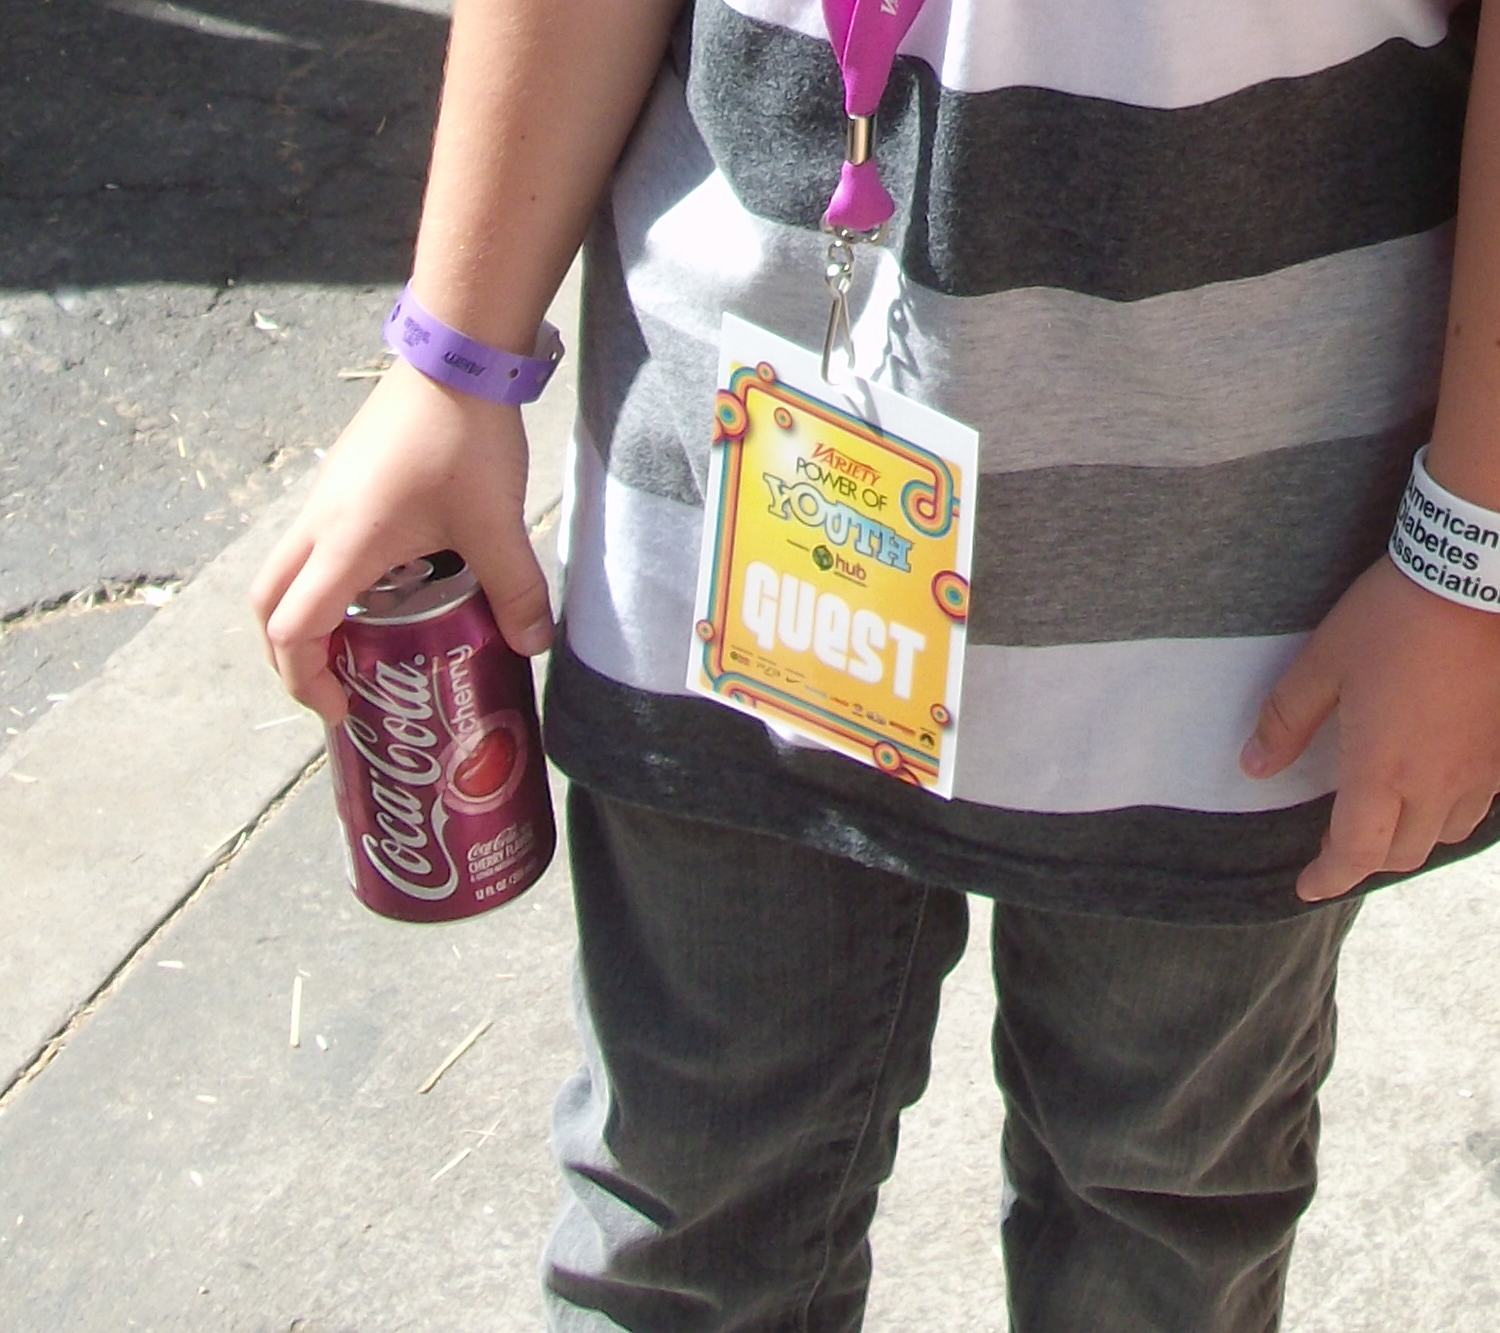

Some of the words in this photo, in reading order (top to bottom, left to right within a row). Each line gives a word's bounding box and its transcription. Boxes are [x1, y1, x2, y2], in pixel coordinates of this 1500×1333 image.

[796, 456, 858, 501] POWER
[861, 487, 889, 512] OF
[811, 442, 882, 487] VARIETY
[762, 471, 915, 574] YOUTH
[1400, 498, 1480, 572] Diabetes
[1406, 475, 1500, 550] American
[835, 553, 868, 582] hub
[447, 644, 474, 733] cherry
